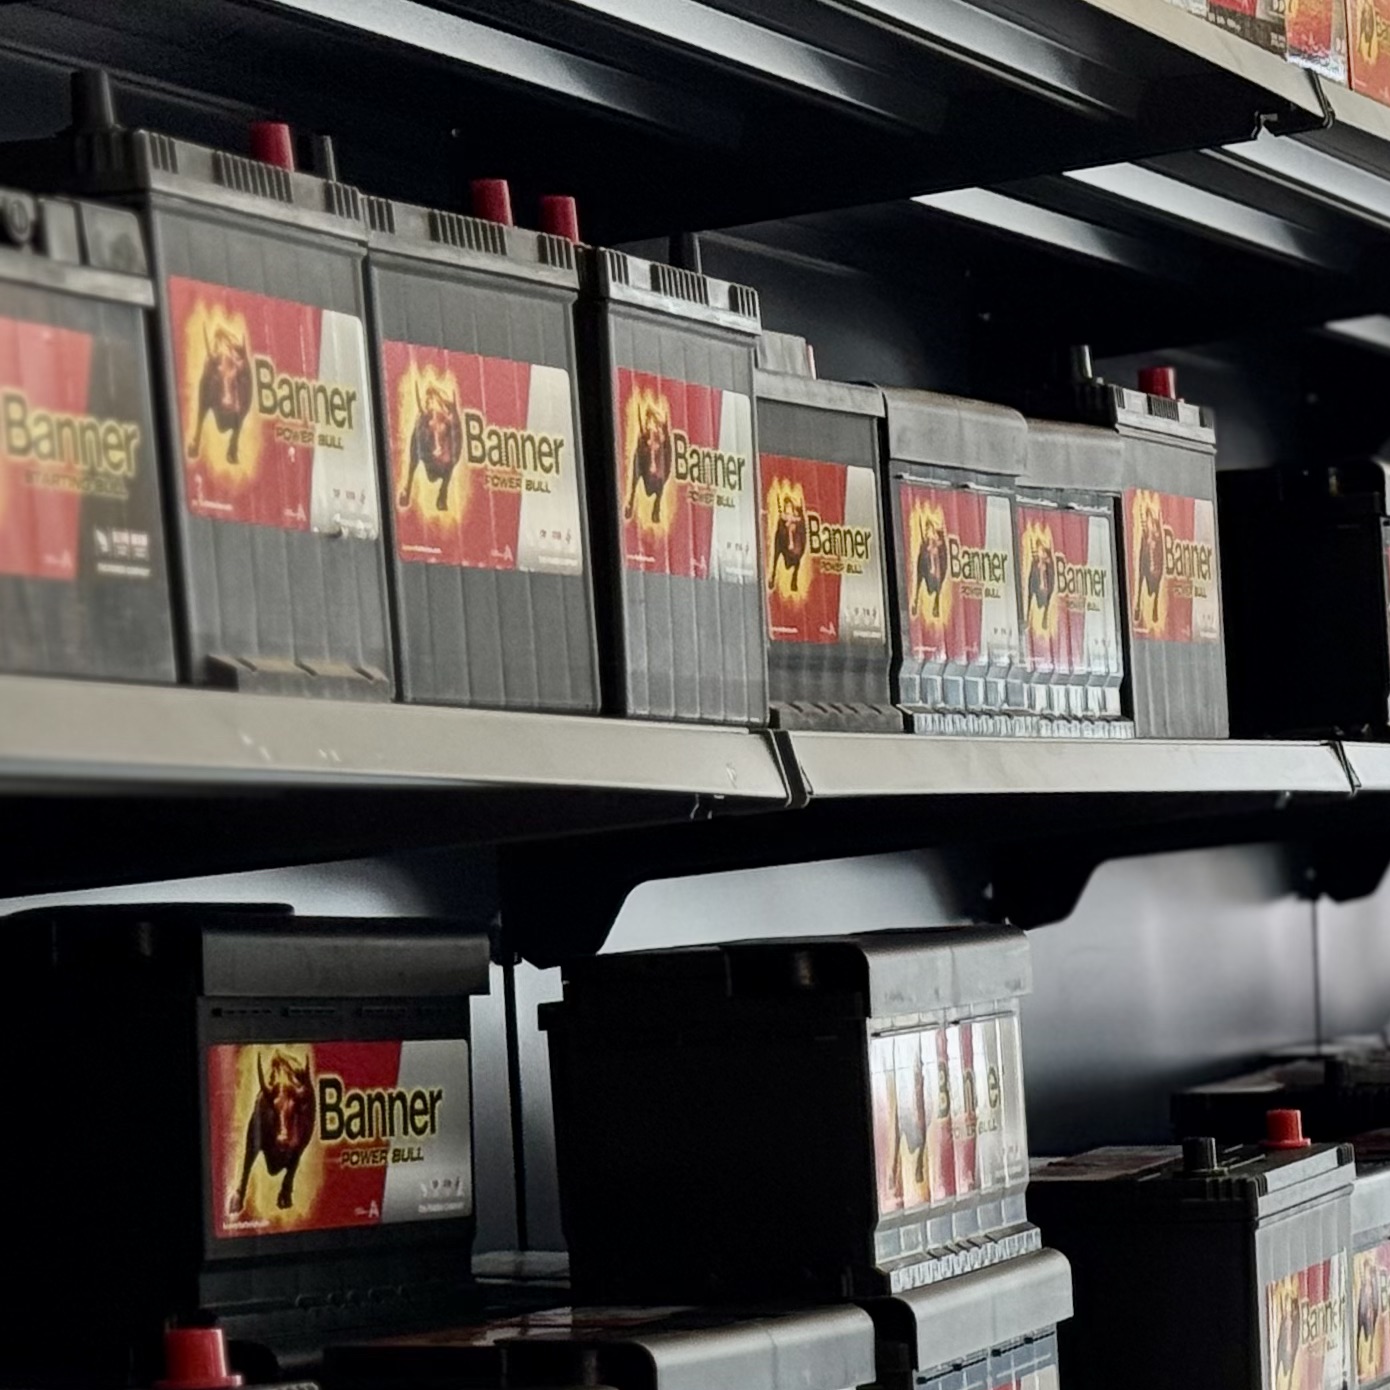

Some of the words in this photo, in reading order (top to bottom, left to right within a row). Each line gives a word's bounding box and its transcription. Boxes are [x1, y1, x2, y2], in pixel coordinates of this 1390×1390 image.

[253, 358, 357, 430] Banner
[3, 391, 139, 477] Banner
[277, 427, 314, 445] POWER
[318, 433, 344, 450] BULL
[464, 411, 565, 475] Banner
[485, 475, 522, 491] POWER
[525, 479, 551, 494] BULL
[672, 432, 746, 491] Banner
[807, 514, 872, 560] Banner
[948, 537, 1008, 583] Banner
[1163, 528, 1212, 580] Banner
[1055, 555, 1107, 598] Banner
[318, 1076, 443, 1141] Banner
[340, 1149, 388, 1167] POWER
[391, 1146, 425, 1164] BULL
